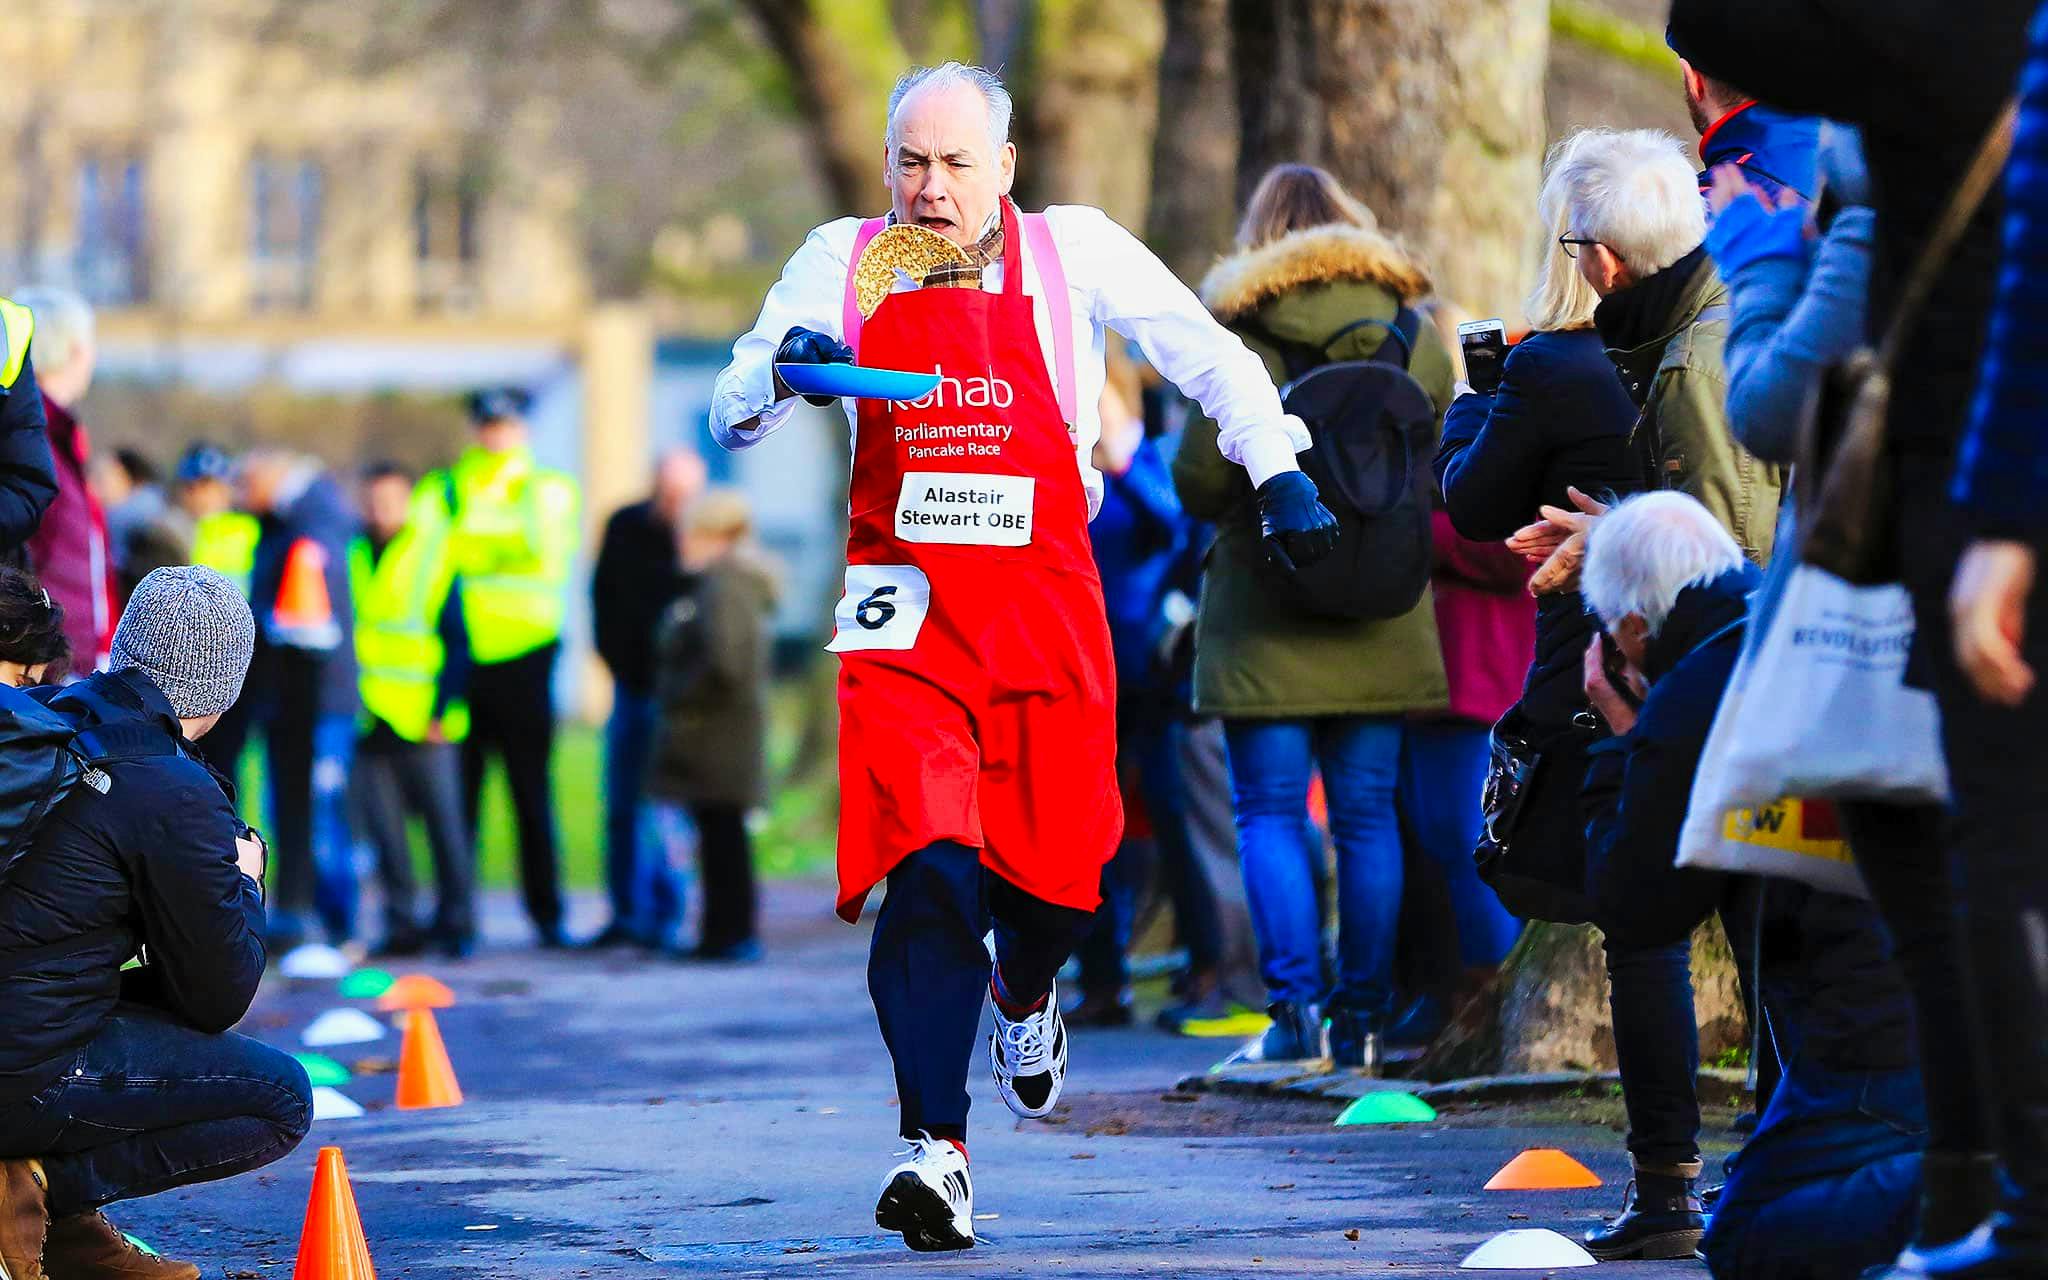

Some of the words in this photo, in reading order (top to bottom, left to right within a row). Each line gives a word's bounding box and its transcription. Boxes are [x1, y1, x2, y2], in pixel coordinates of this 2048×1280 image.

[895, 422, 1013, 442] Parliamentary
[909, 442, 965, 460] Pancake
[968, 442, 1001, 456] Race
[924, 487, 1005, 505] Alastair
[901, 509, 981, 527] Stewart
[988, 512, 1026, 530] OBE
[856, 585, 897, 630] 6
